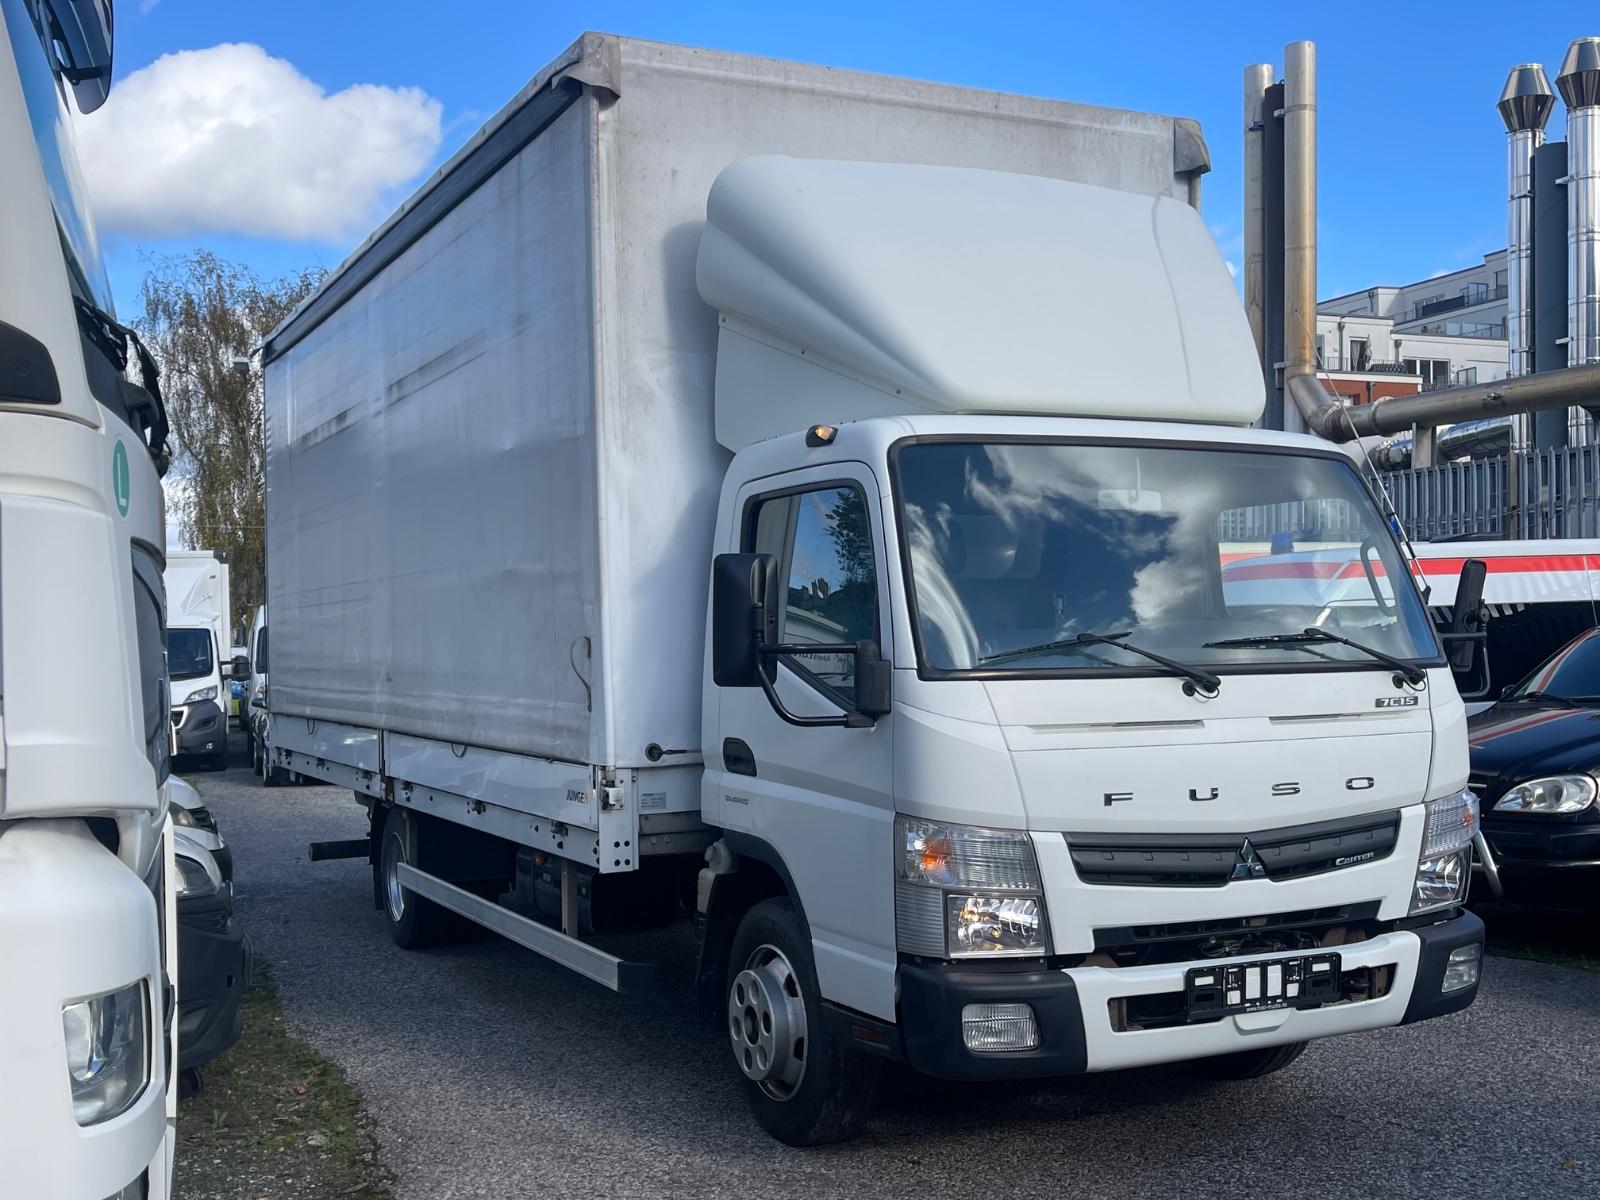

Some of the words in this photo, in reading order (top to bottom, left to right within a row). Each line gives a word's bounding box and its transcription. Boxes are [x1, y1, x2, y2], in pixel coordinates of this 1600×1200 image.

[117, 452, 127, 507] L
[1380, 697, 1415, 707] 7C15
[1104, 776, 1375, 806] FUSO
